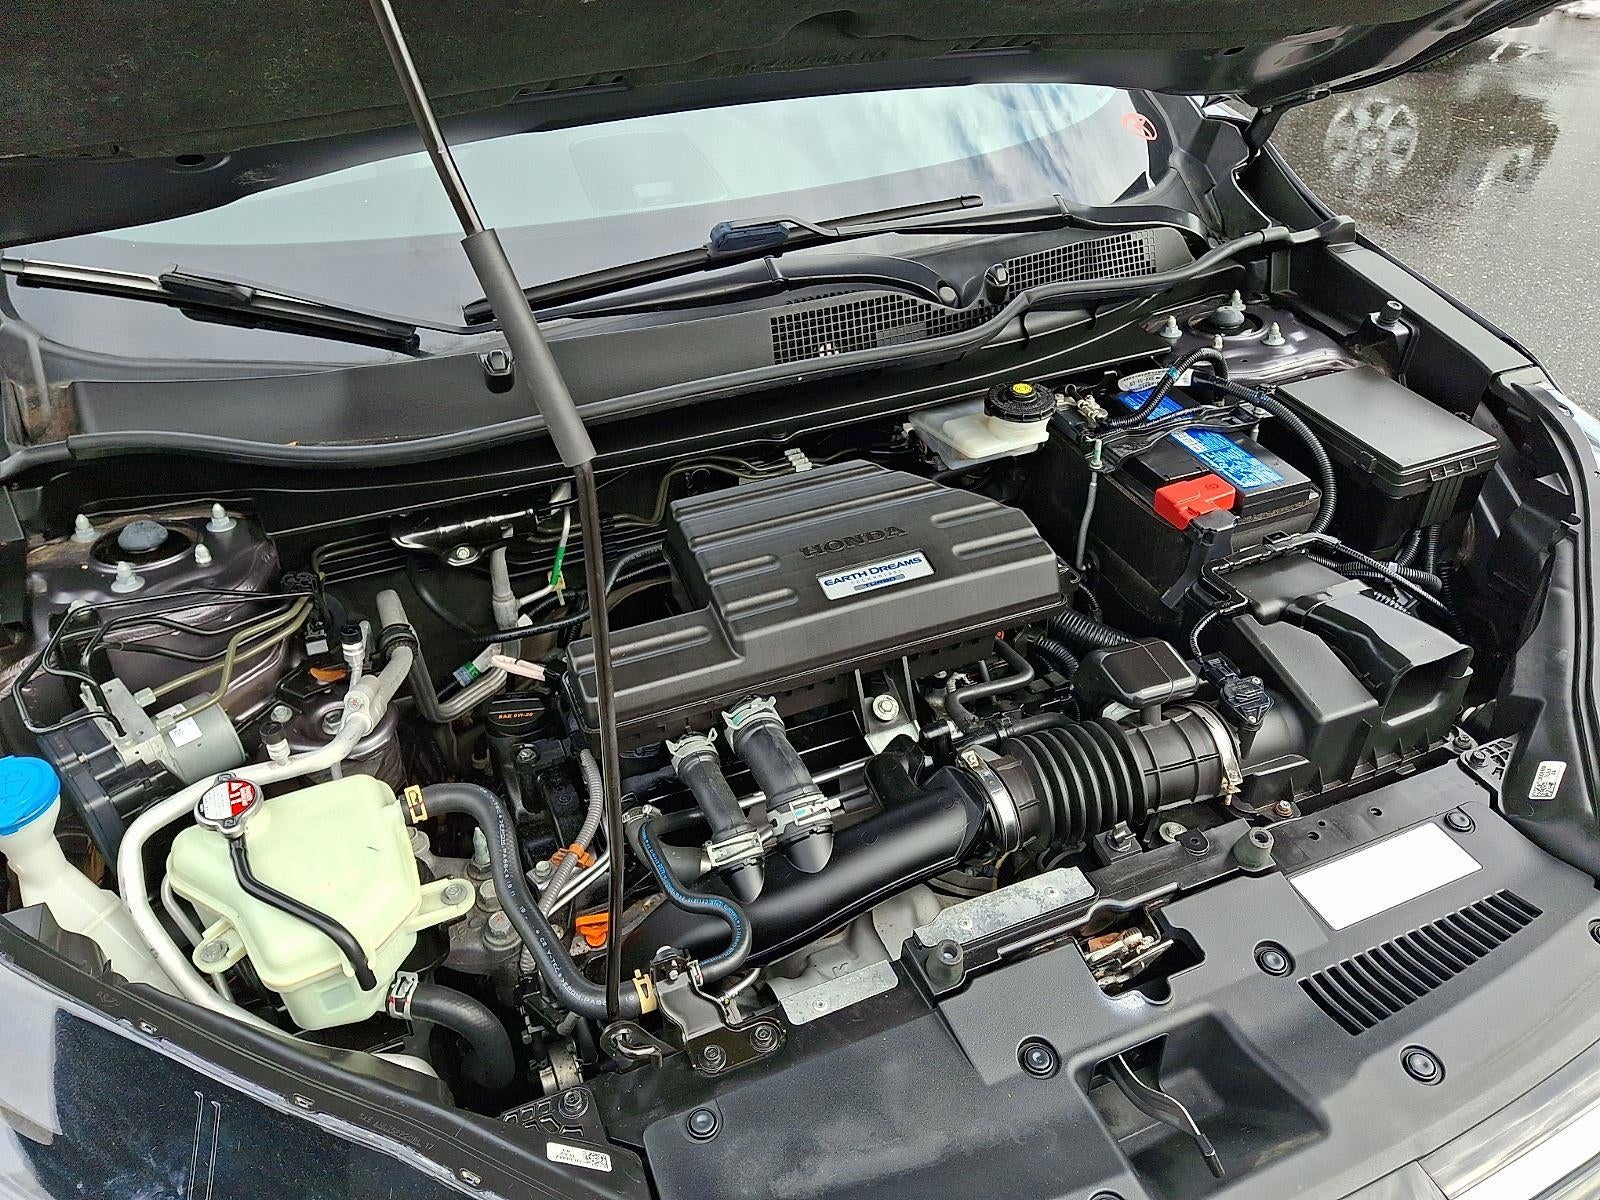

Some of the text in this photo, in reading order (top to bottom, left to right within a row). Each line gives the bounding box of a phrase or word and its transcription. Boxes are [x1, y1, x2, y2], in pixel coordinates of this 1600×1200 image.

[800, 526, 908, 558] HONDA
[823, 556, 923, 587] EARTH DREAMS
